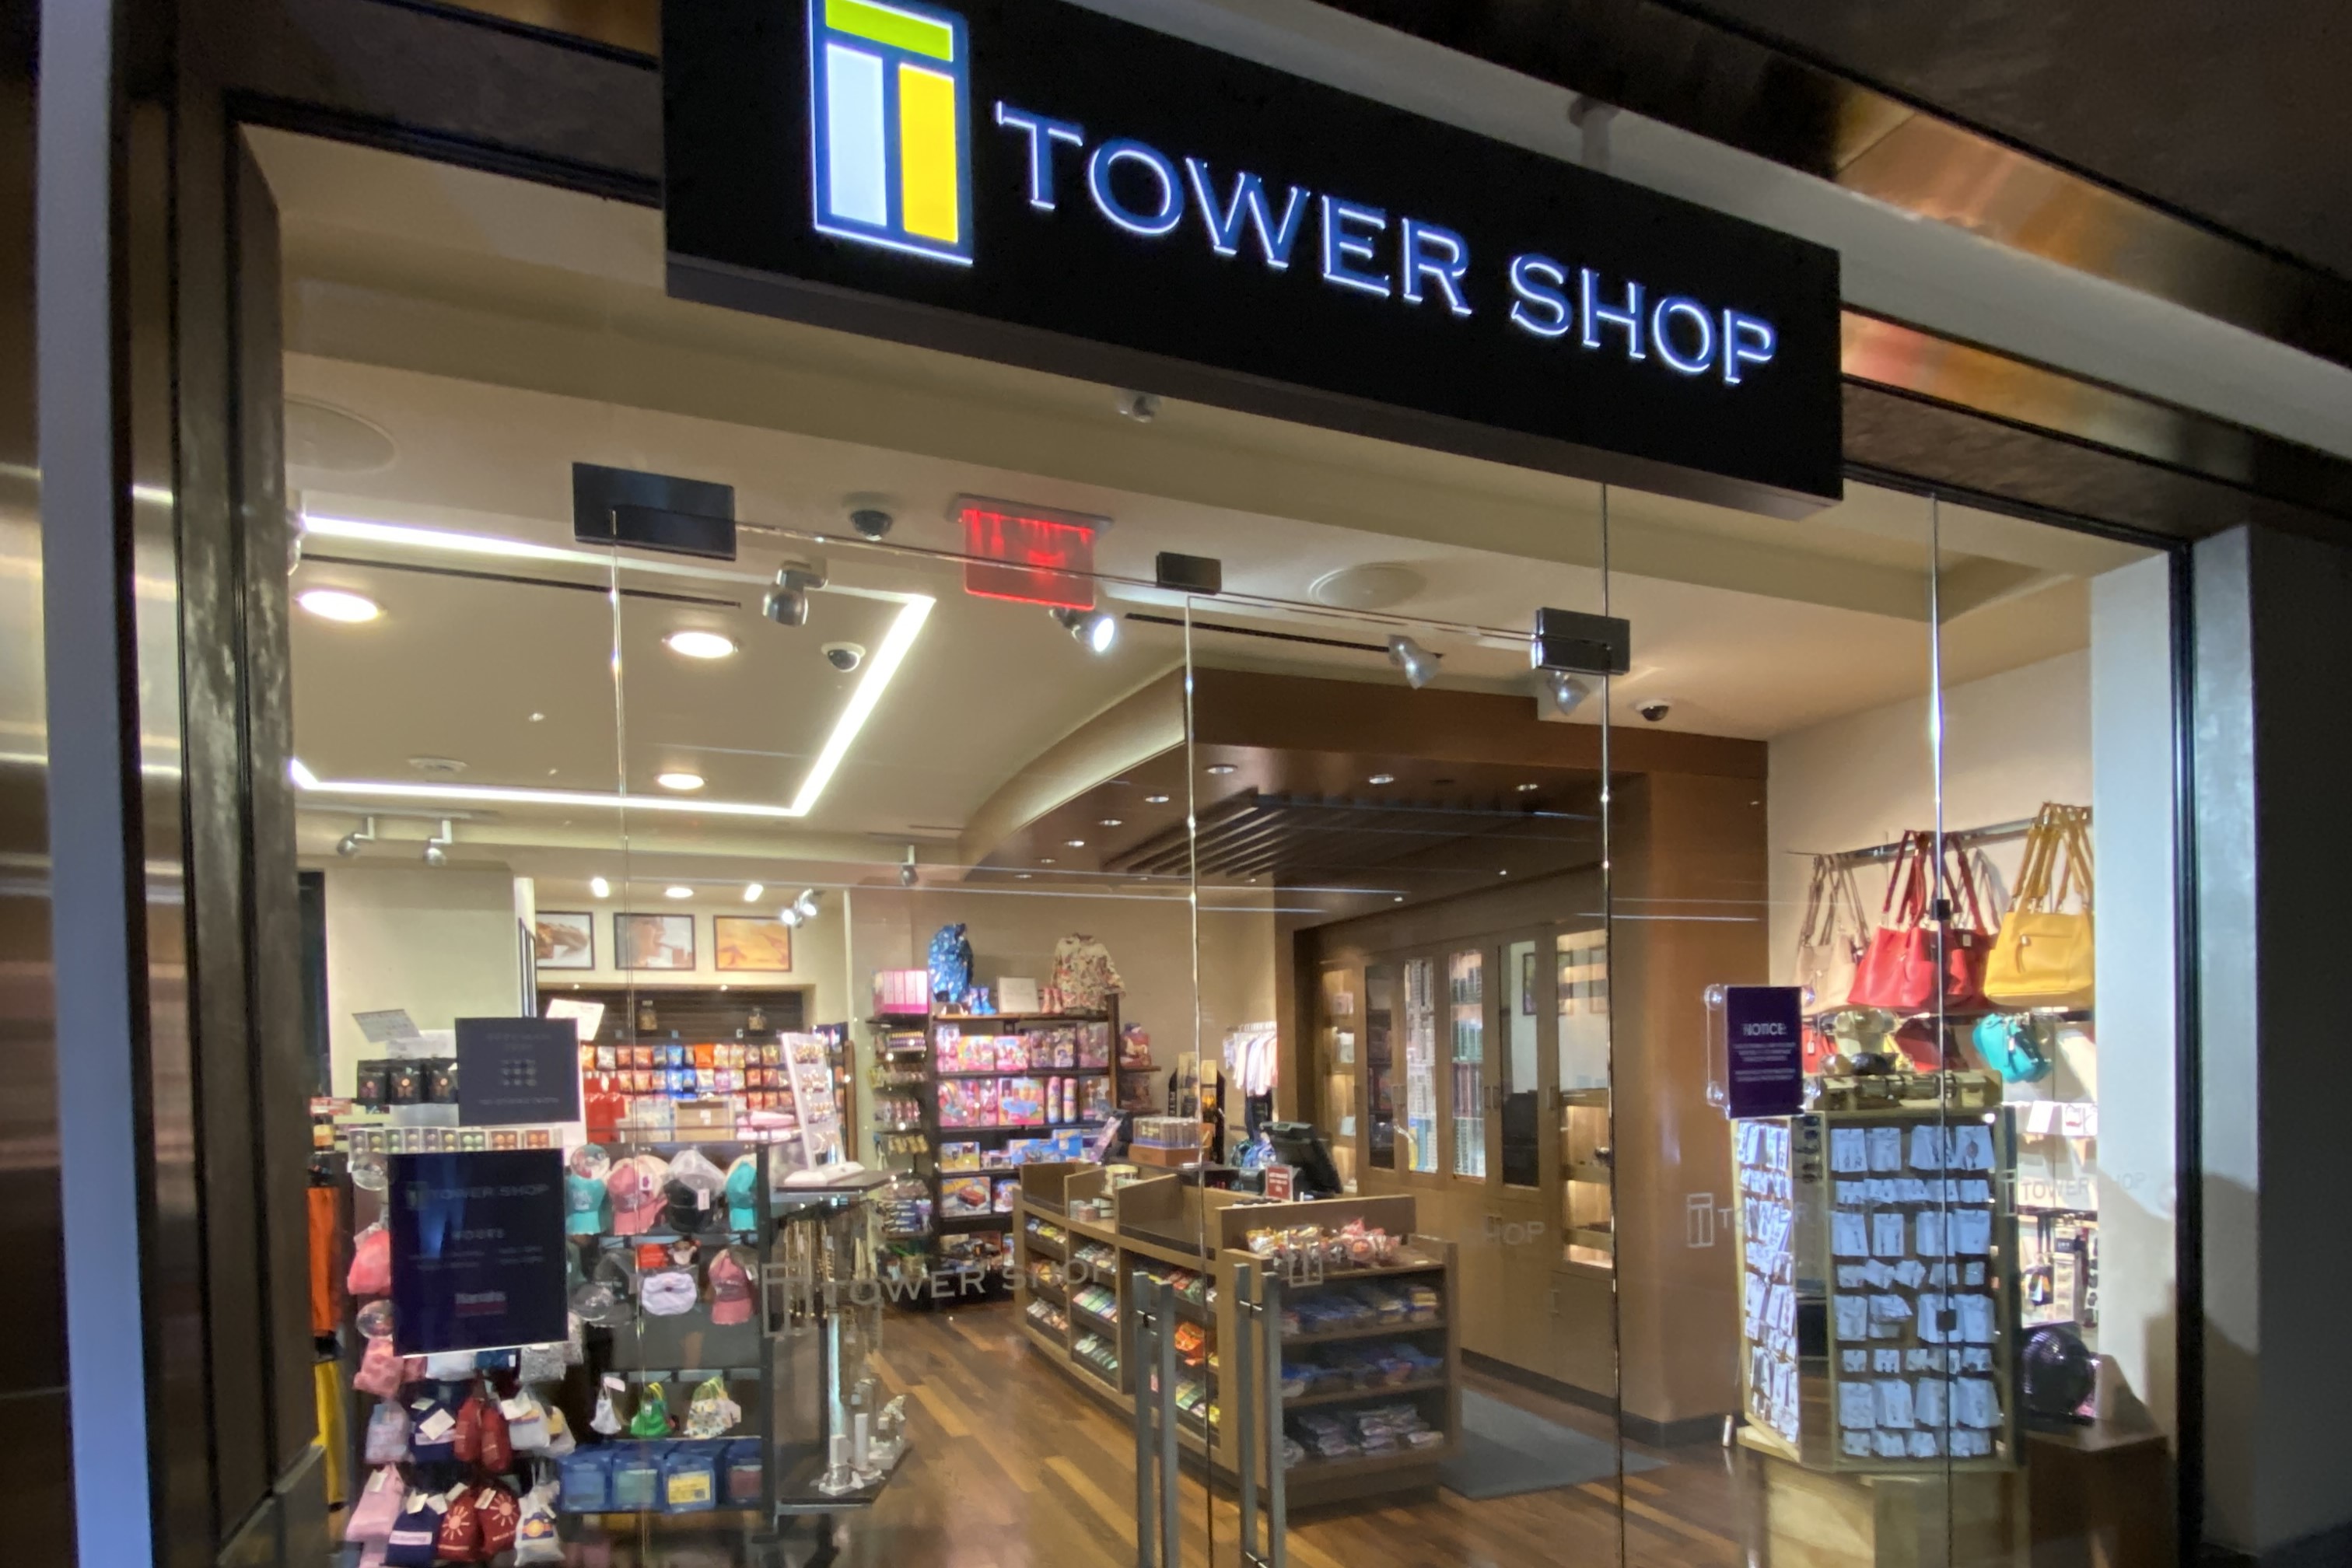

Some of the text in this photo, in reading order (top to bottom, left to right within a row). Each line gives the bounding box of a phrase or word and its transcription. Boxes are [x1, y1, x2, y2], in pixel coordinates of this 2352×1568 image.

[996, 100, 1778, 384] TOWER SHOP
[2021, 1177, 2089, 1201] TOWER
[821, 1269, 986, 1308] TOWER
